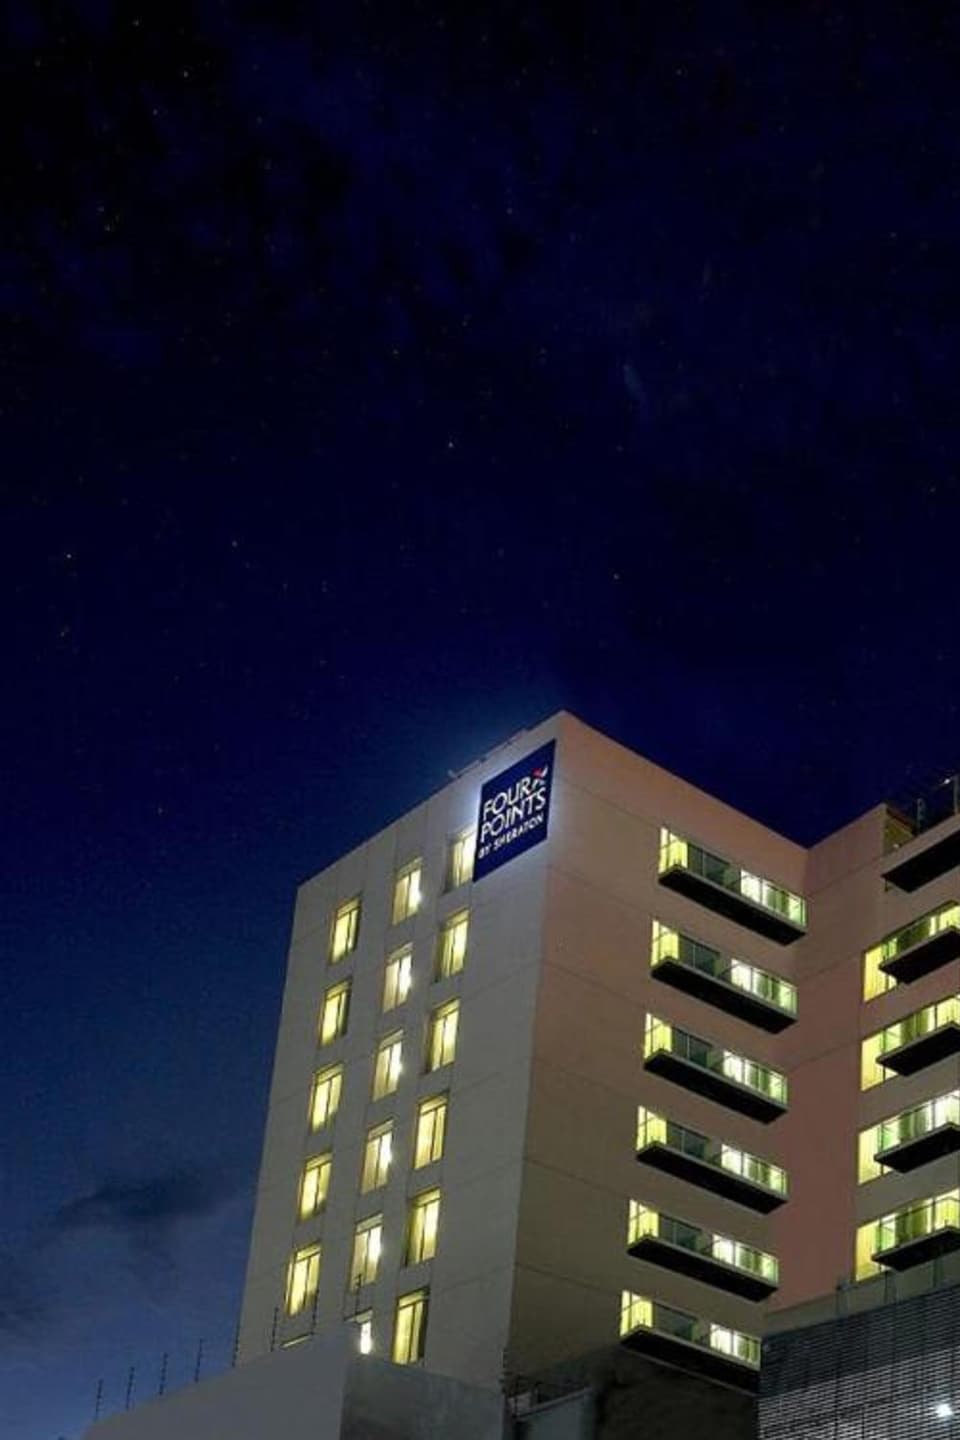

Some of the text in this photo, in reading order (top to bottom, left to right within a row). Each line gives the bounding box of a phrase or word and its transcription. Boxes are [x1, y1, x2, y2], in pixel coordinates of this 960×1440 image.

[480, 786, 547, 843] POINTS
[483, 776, 534, 821] FOUR
[478, 812, 544, 859] BY SHERATON
